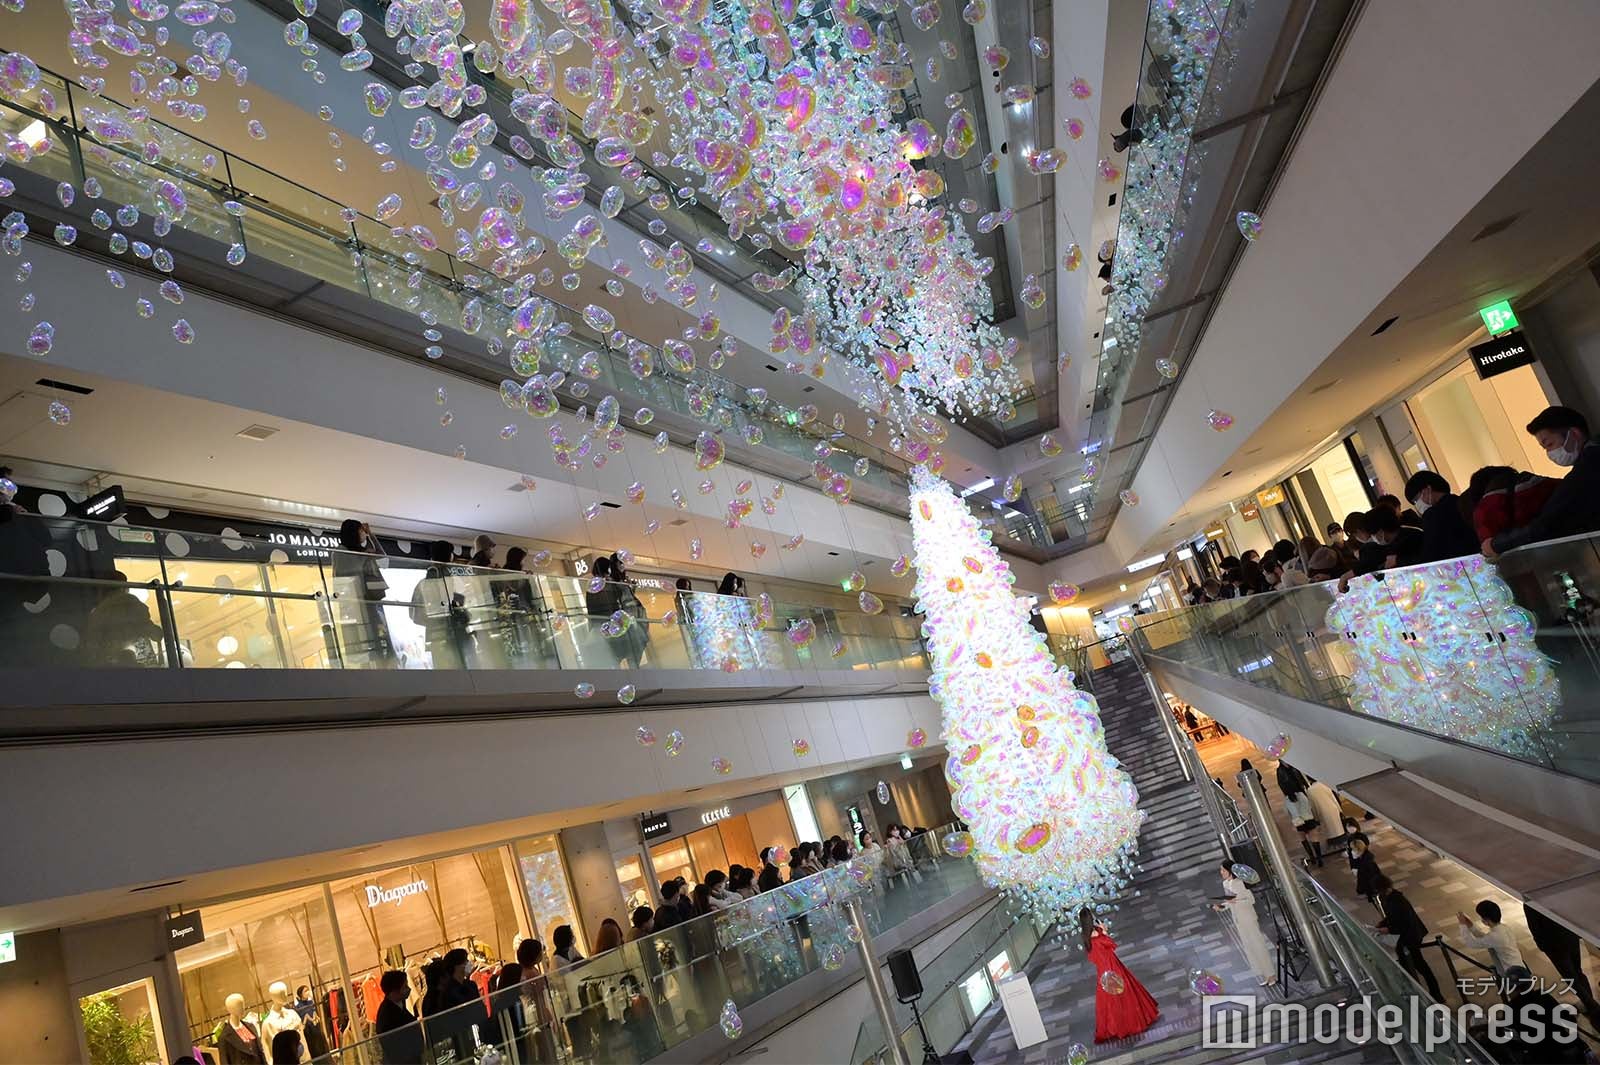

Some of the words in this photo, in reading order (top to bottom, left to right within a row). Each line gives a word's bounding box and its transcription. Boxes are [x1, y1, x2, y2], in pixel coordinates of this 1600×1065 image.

[1480, 346, 1525, 366] Hirotaka
[268, 533, 287, 545] JO
[289, 534, 342, 548] MALON
[364, 879, 429, 908] Diagram
